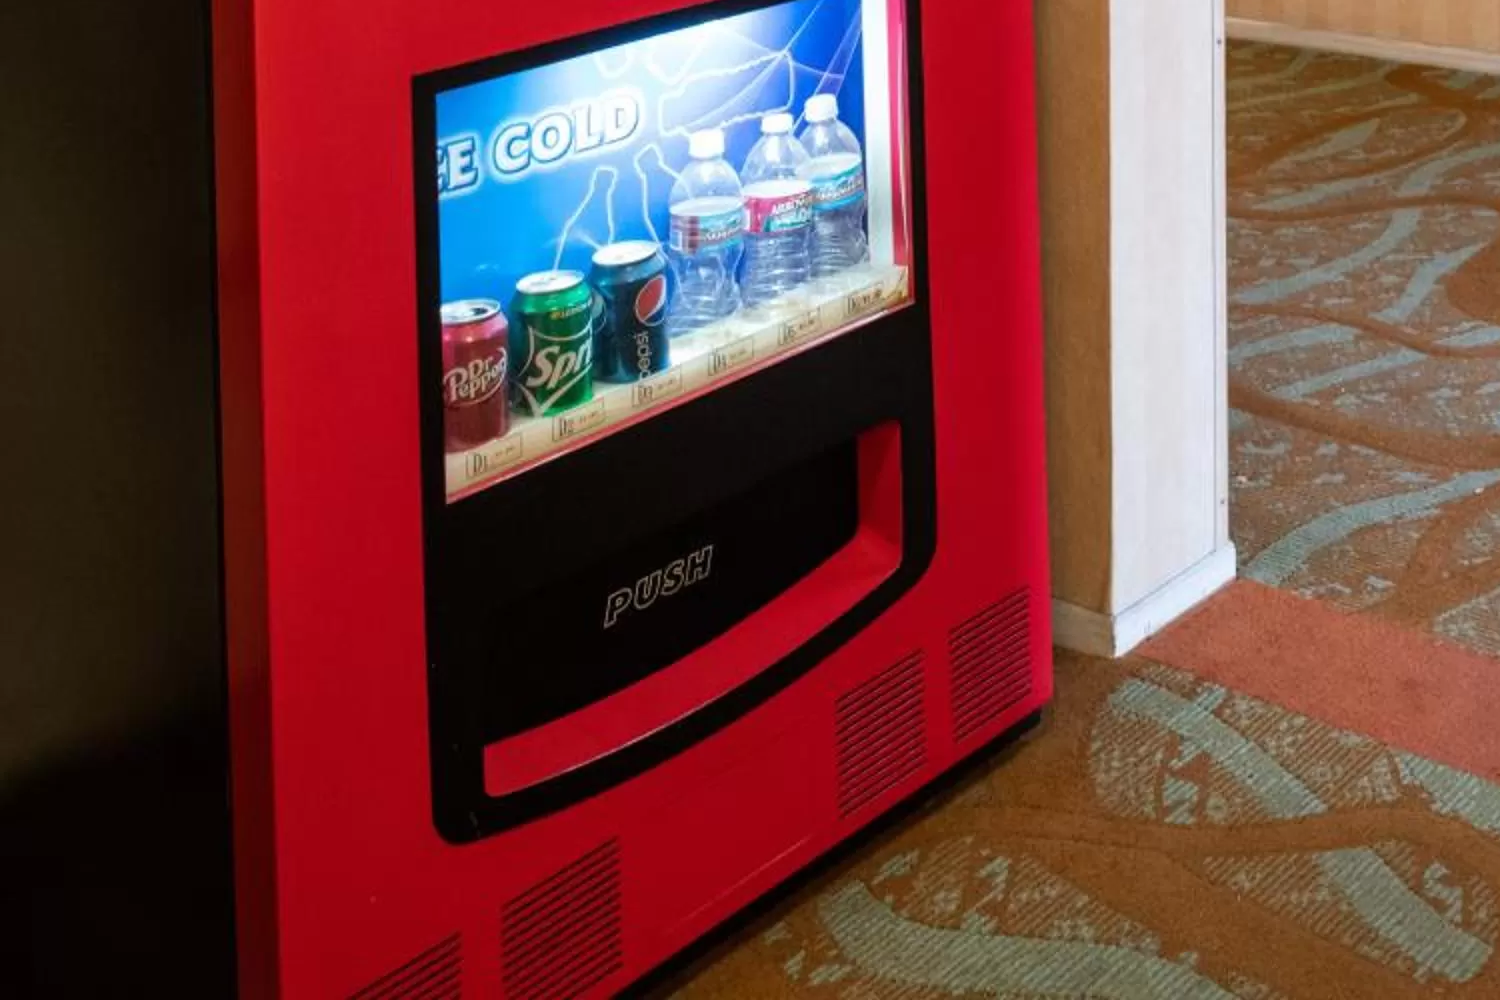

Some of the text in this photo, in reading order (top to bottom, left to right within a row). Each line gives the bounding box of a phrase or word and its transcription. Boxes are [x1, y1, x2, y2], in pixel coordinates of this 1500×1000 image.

[493, 95, 639, 175] COLD
[467, 356, 494, 376] Dr
[526, 340, 592, 390] Spri
[473, 452, 487, 474] D1
[603, 545, 714, 630] PUSH
